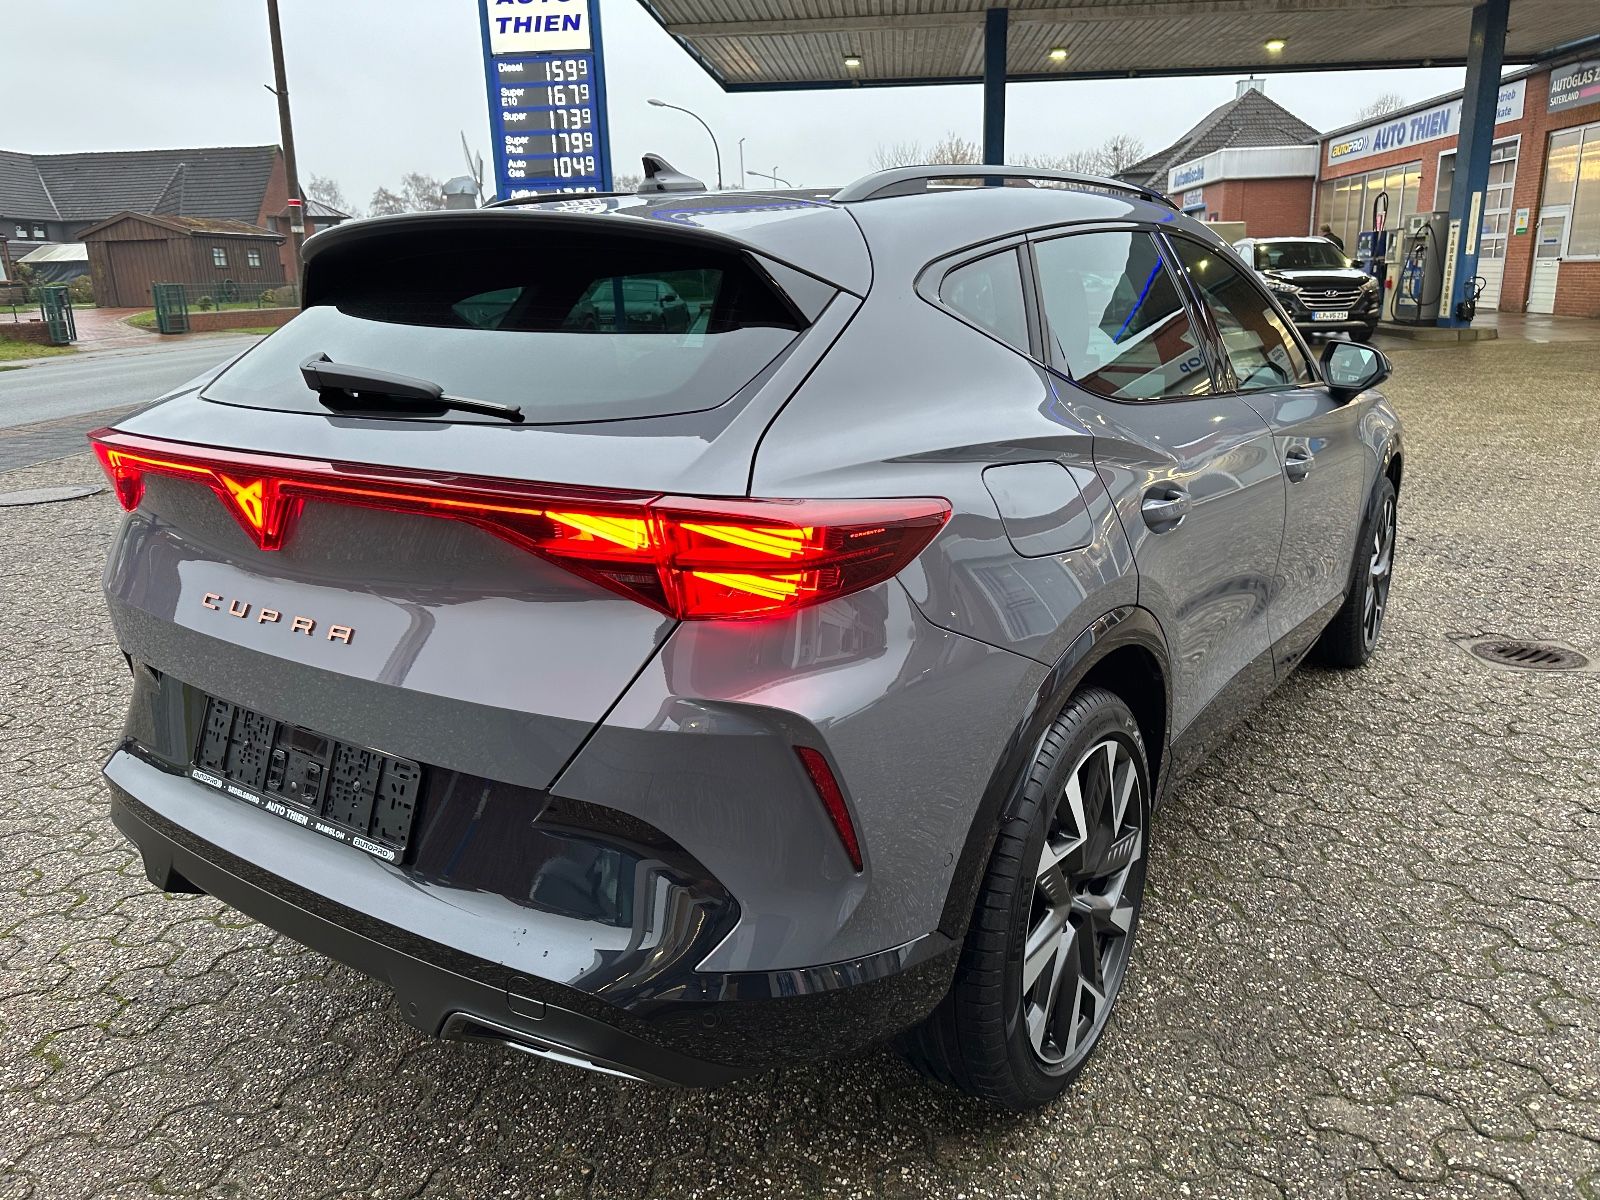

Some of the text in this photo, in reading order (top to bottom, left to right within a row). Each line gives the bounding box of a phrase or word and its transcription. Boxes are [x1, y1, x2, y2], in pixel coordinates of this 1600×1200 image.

[496, 14, 582, 34] THIEN
[498, 62, 523, 72] Diesel
[1551, 69, 1593, 93] AUTOGLAS
[500, 87, 525, 98] Super
[501, 97, 518, 107] E10
[1549, 91, 1580, 106] SATERLAND
[502, 112, 528, 122] Super
[1496, 106, 1512, 118] kate
[1373, 122, 1407, 152] AUTO
[1409, 108, 1452, 143] THIEN
[505, 135, 530, 146] Super
[507, 159, 527, 169] Auto
[508, 168, 526, 178] Gas
[201, 592, 356, 645] CUPRA
[228, 785, 260, 805] SEDELSBERG
[265, 800, 286, 816] AUTO
[286, 808, 309, 826] THIEN
[315, 822, 345, 840] RAMSLOH
